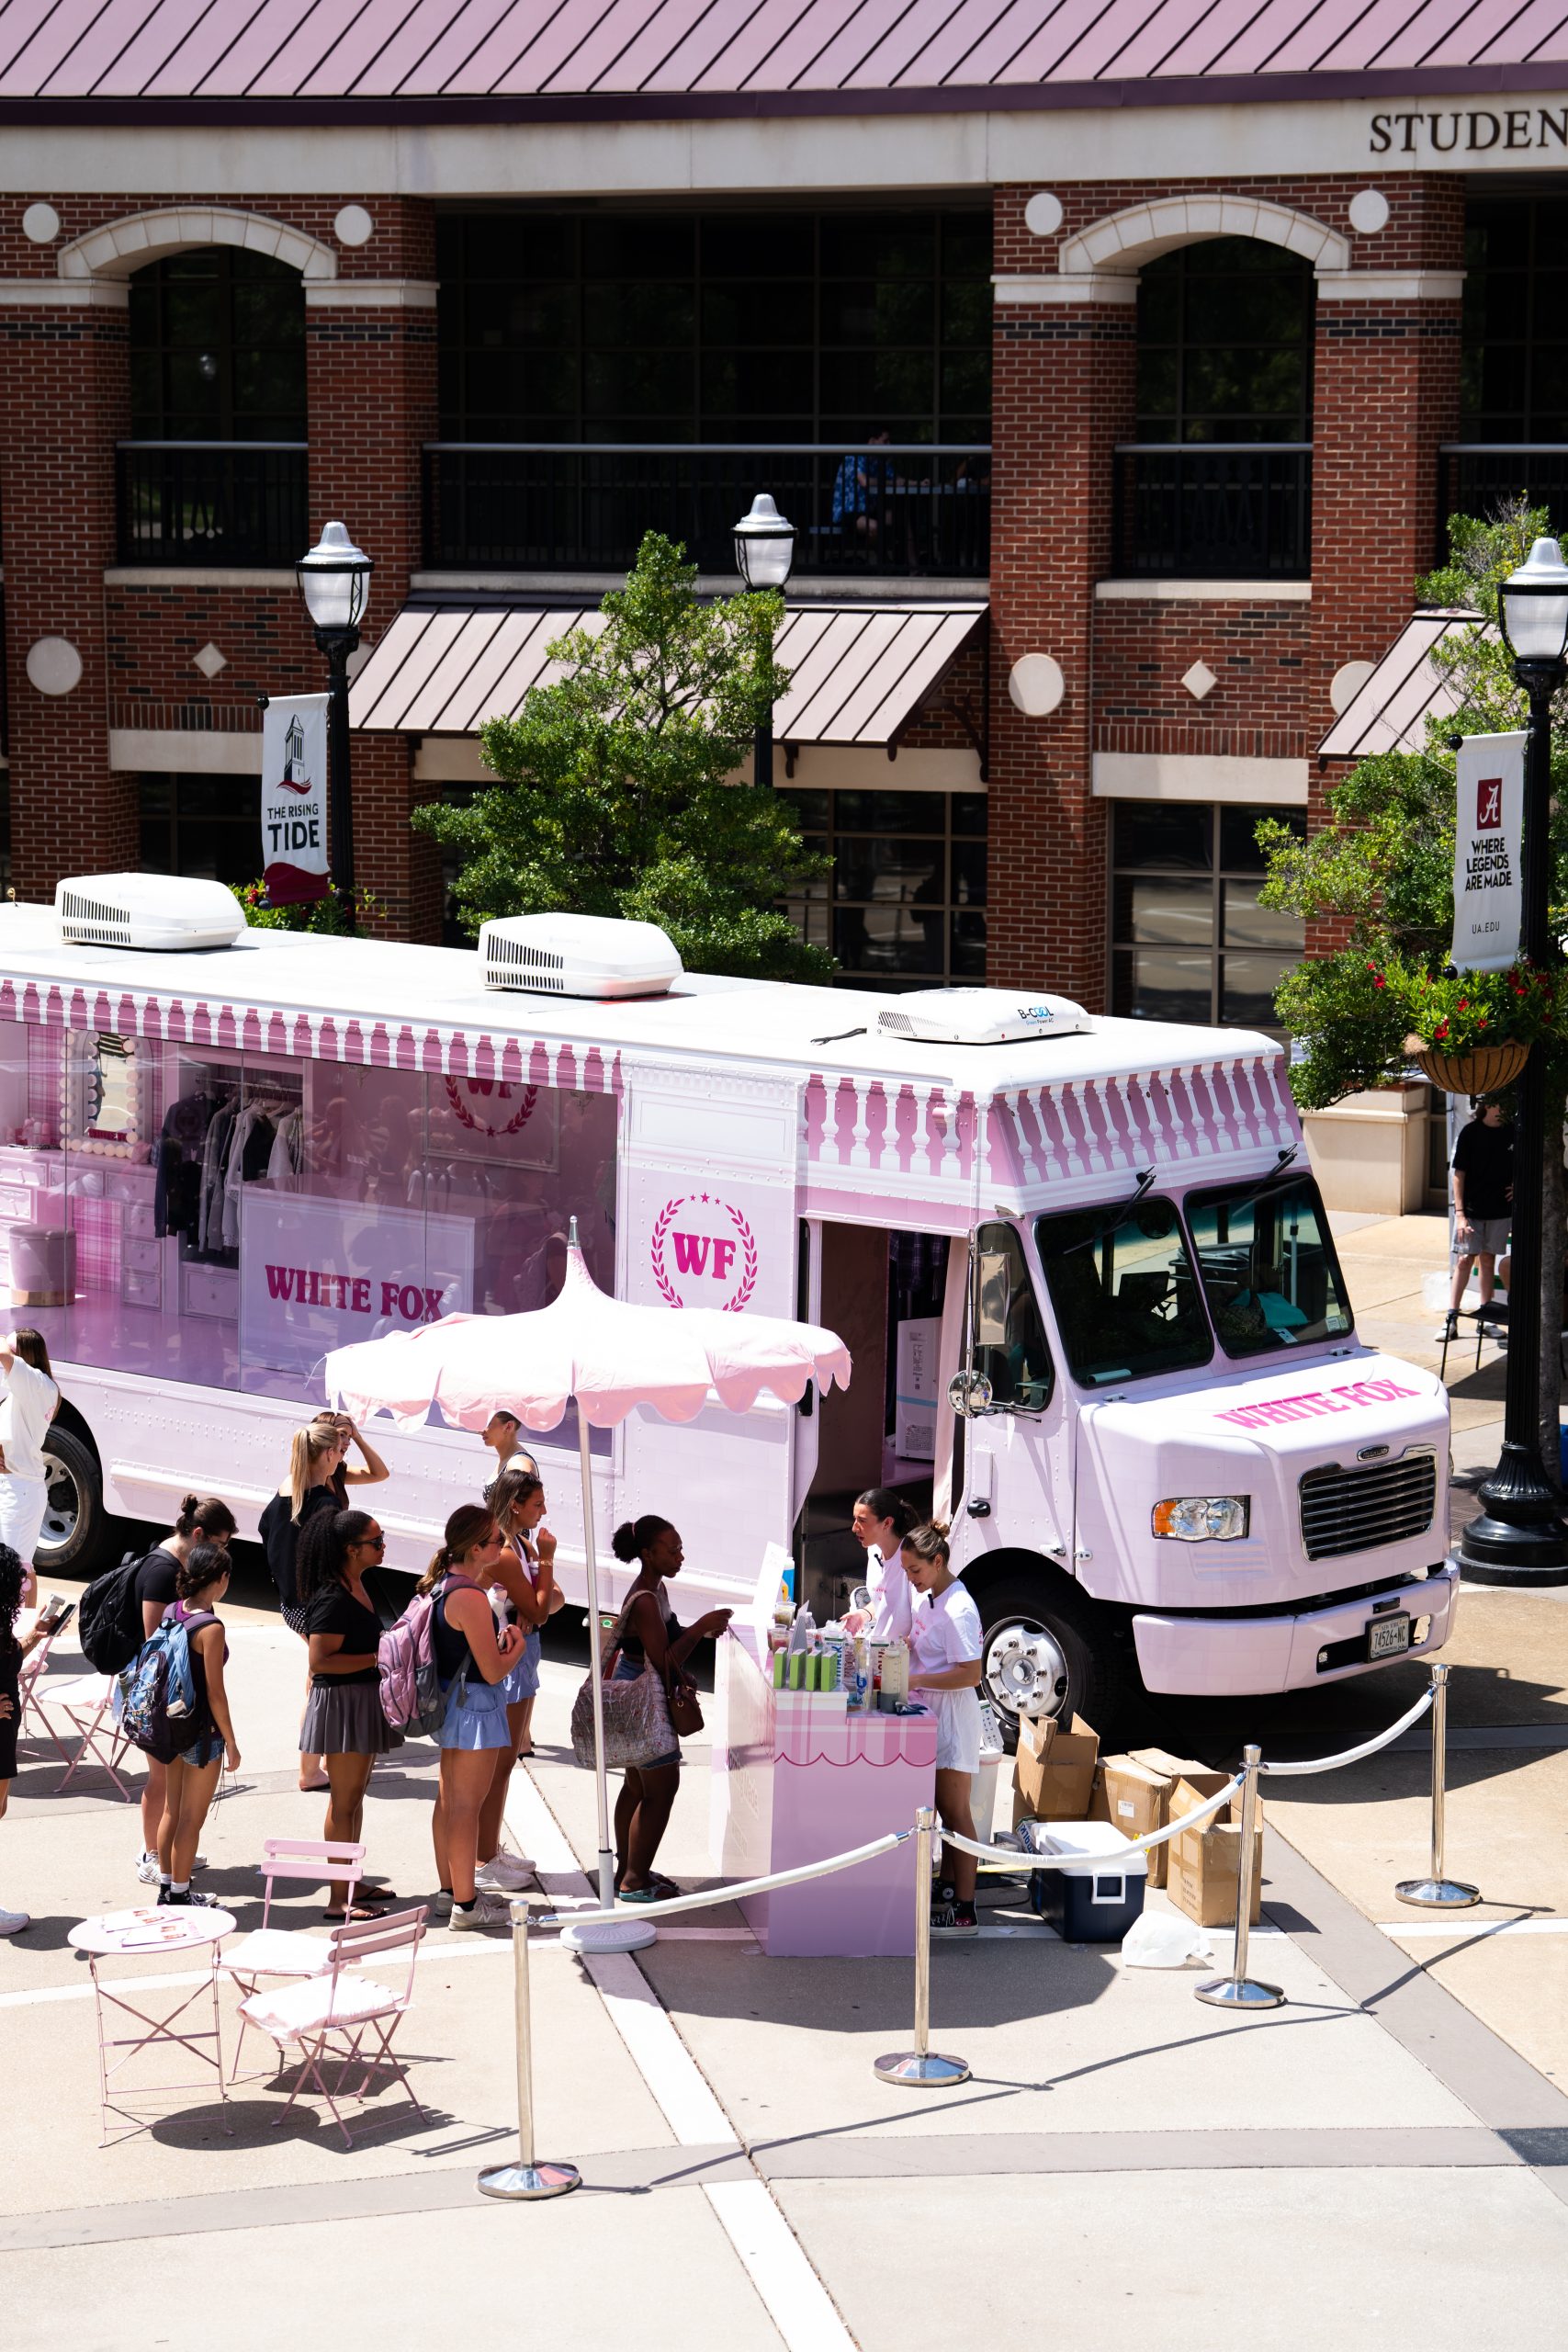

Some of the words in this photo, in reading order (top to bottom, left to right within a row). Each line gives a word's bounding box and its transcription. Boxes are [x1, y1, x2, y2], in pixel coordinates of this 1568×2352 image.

[266, 807, 286, 820] THE
[288, 803, 319, 818] RISING
[267, 820, 320, 852] TIDE
[1472, 837, 1506, 854] WHERE
[1466, 854, 1509, 874] LEGENDS
[1465, 875, 1483, 892] ARE
[1484, 871, 1512, 889] MADE
[1472, 922, 1500, 934] UA.EDU
[672, 1232, 736, 1280] WF
[265, 1264, 372, 1313] WHITE
[380, 1282, 444, 1323] FOX
[1213, 1392, 1352, 1430] WHITE
[1331, 1379, 1421, 1407] FOX
